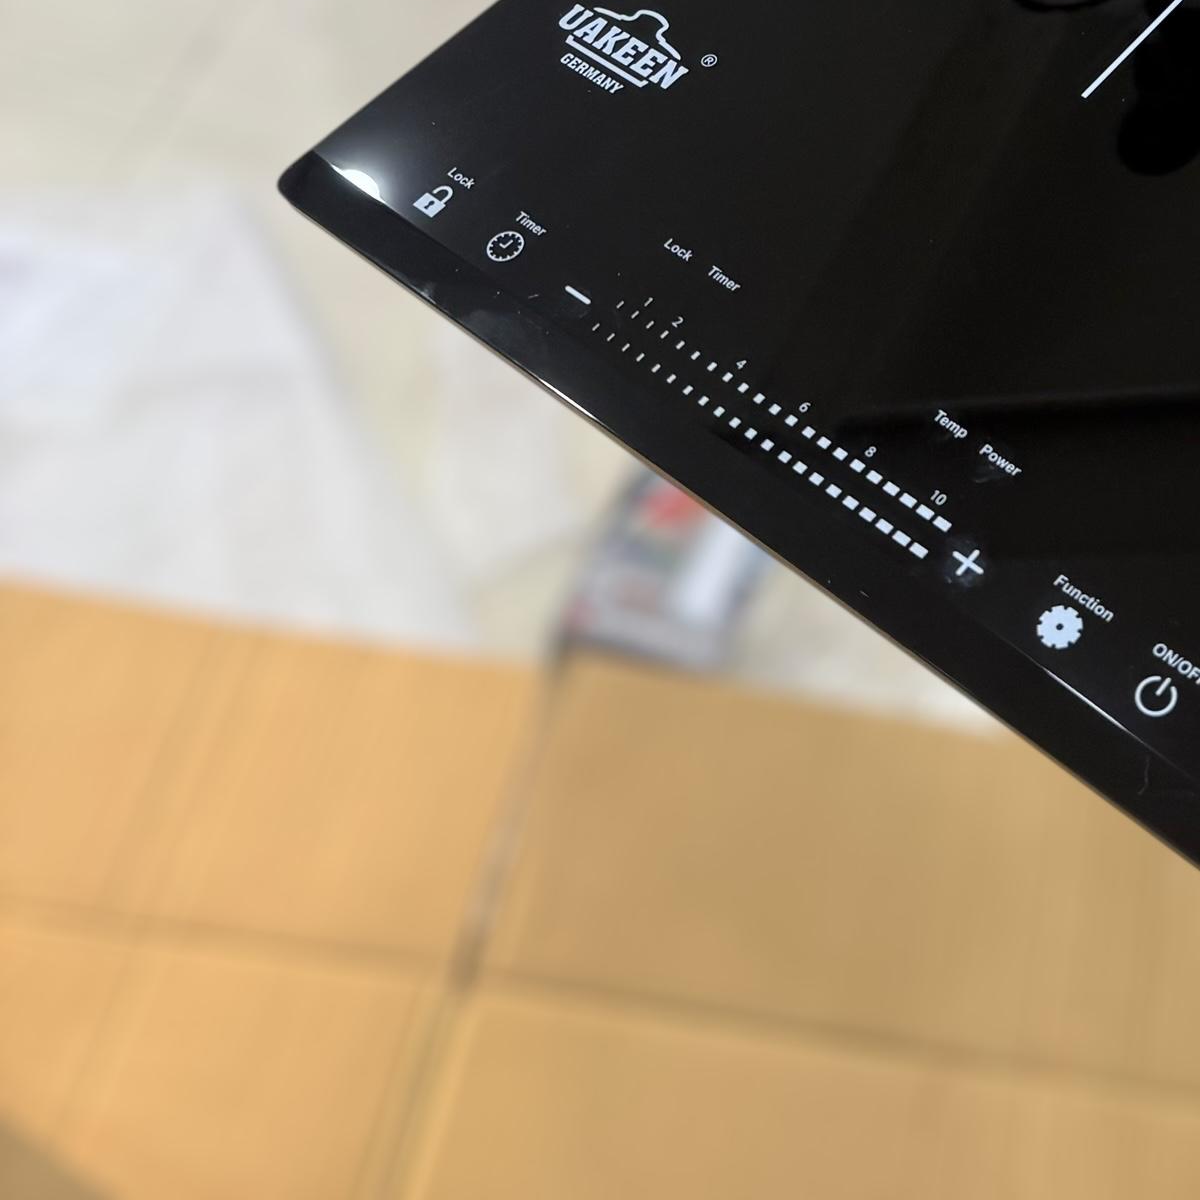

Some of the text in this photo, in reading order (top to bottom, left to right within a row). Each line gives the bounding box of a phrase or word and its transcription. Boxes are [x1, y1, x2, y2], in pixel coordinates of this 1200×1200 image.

[560, 52, 625, 94] GERMANY
[447, 166, 475, 190] Lock
[515, 210, 547, 237] Timer
[663, 238, 693, 262] Lock
[708, 265, 741, 291] Timer
[671, 316, 684, 328] 2
[735, 358, 748, 370] 4
[798, 402, 811, 413] 6
[864, 446, 877, 458] 8
[929, 489, 947, 506] 10
[934, 409, 968, 439] Temp
[979, 443, 1022, 477] Power
[1053, 574, 1114, 622] Function
